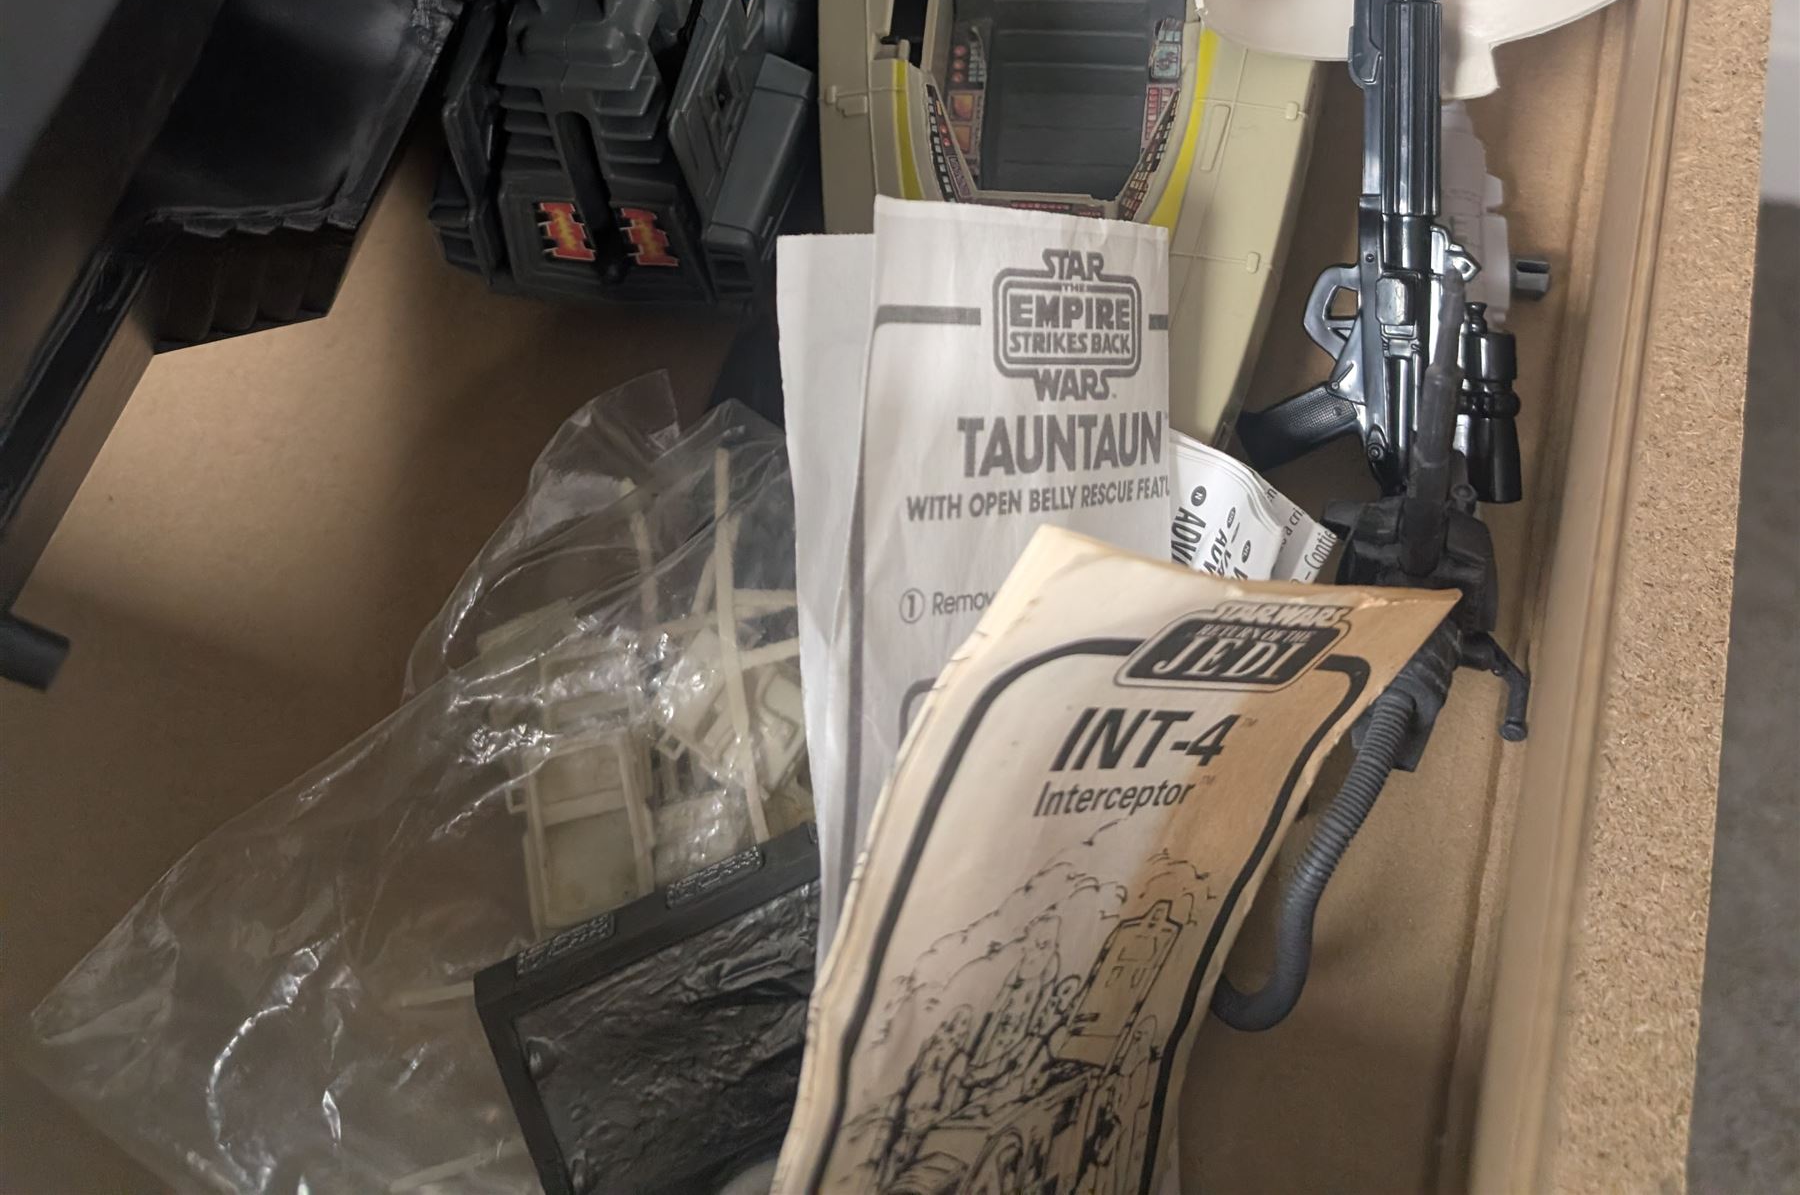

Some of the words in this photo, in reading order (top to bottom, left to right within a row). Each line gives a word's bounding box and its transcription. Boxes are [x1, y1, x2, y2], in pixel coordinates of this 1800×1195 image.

[1042, 248, 1104, 281] STAR
[1061, 283, 1087, 293] THE
[1009, 294, 1130, 330] EMPIRE
[1009, 331, 1088, 353] STRIKES
[1091, 333, 1130, 354] BACK
[957, 410, 1162, 478] TAUNTAUN
[907, 493, 962, 521] WITH
[968, 489, 1022, 517] OPEN
[1029, 485, 1077, 513] BELLY
[1081, 479, 1133, 507] RESCUE
[1214, 603, 1281, 623] STAR
[1271, 605, 1352, 627] WARS
[1152, 637, 1306, 679] JEDI
[1049, 707, 1241, 772] INT-4
[1033, 780, 1196, 817] Interceptor
